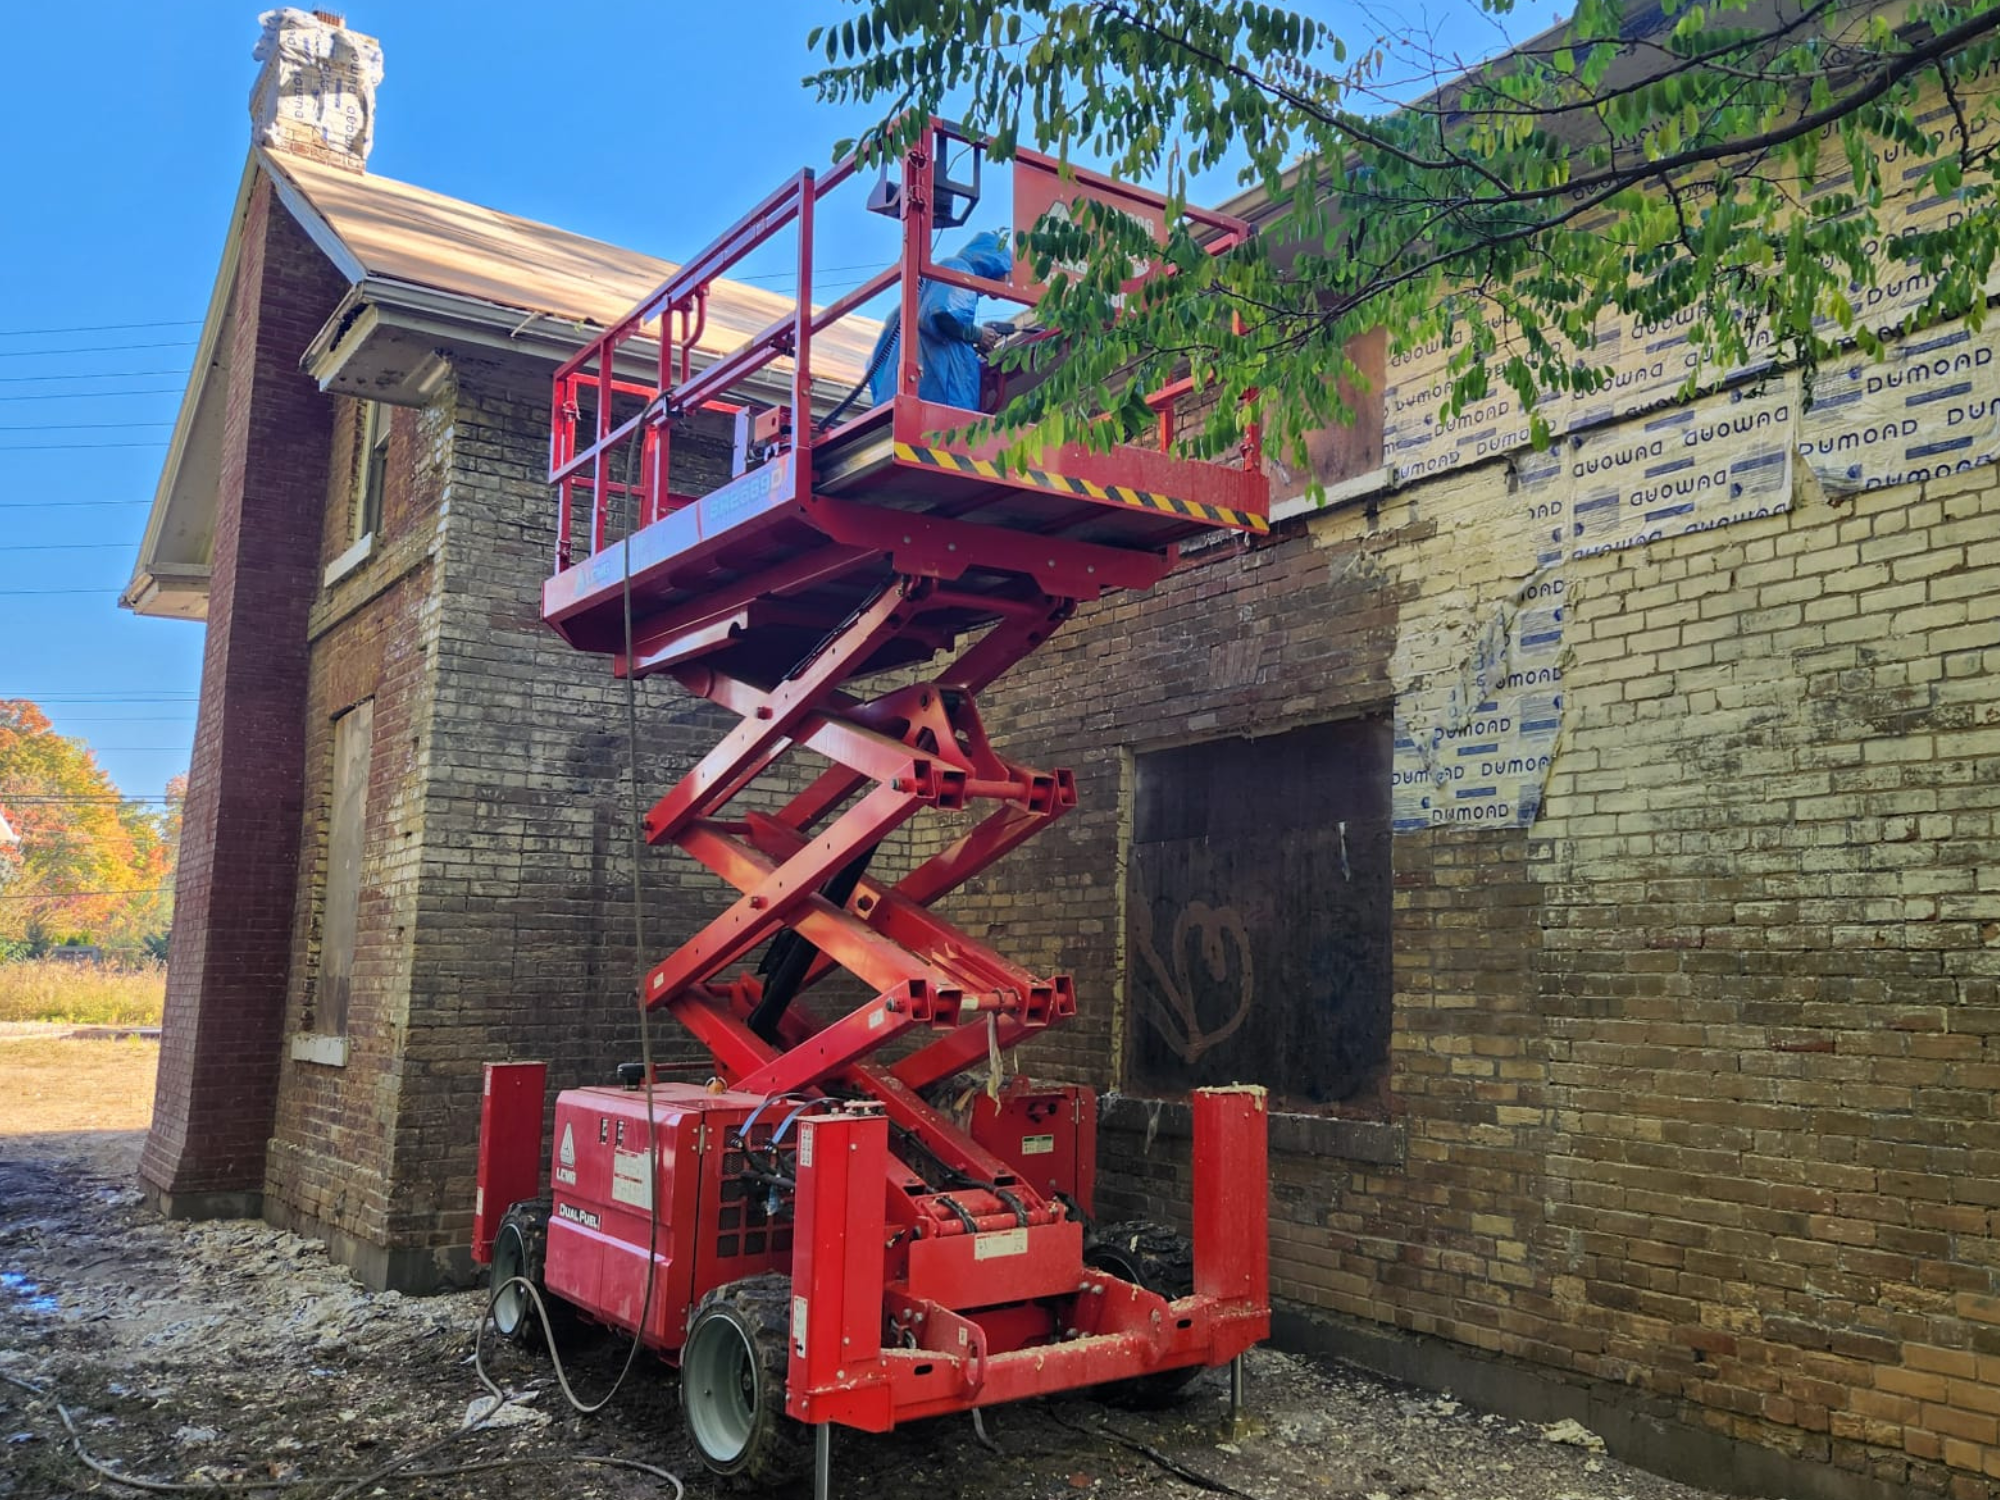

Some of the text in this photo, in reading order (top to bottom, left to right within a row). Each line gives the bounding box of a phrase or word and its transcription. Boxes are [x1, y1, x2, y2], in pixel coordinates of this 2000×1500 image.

[1867, 347, 1992, 394] DUMOND
[1435, 401, 1509, 438] DUMOND
[1684, 406, 1788, 447] DUMOND
[1799, 419, 1918, 457] DUMOND
[1572, 440, 1663, 478] DUMOND
[1630, 469, 1727, 507] DUMOND
[1434, 718, 1511, 741] DUMOND
[559, 1202, 598, 1228] DUAL FUEL
